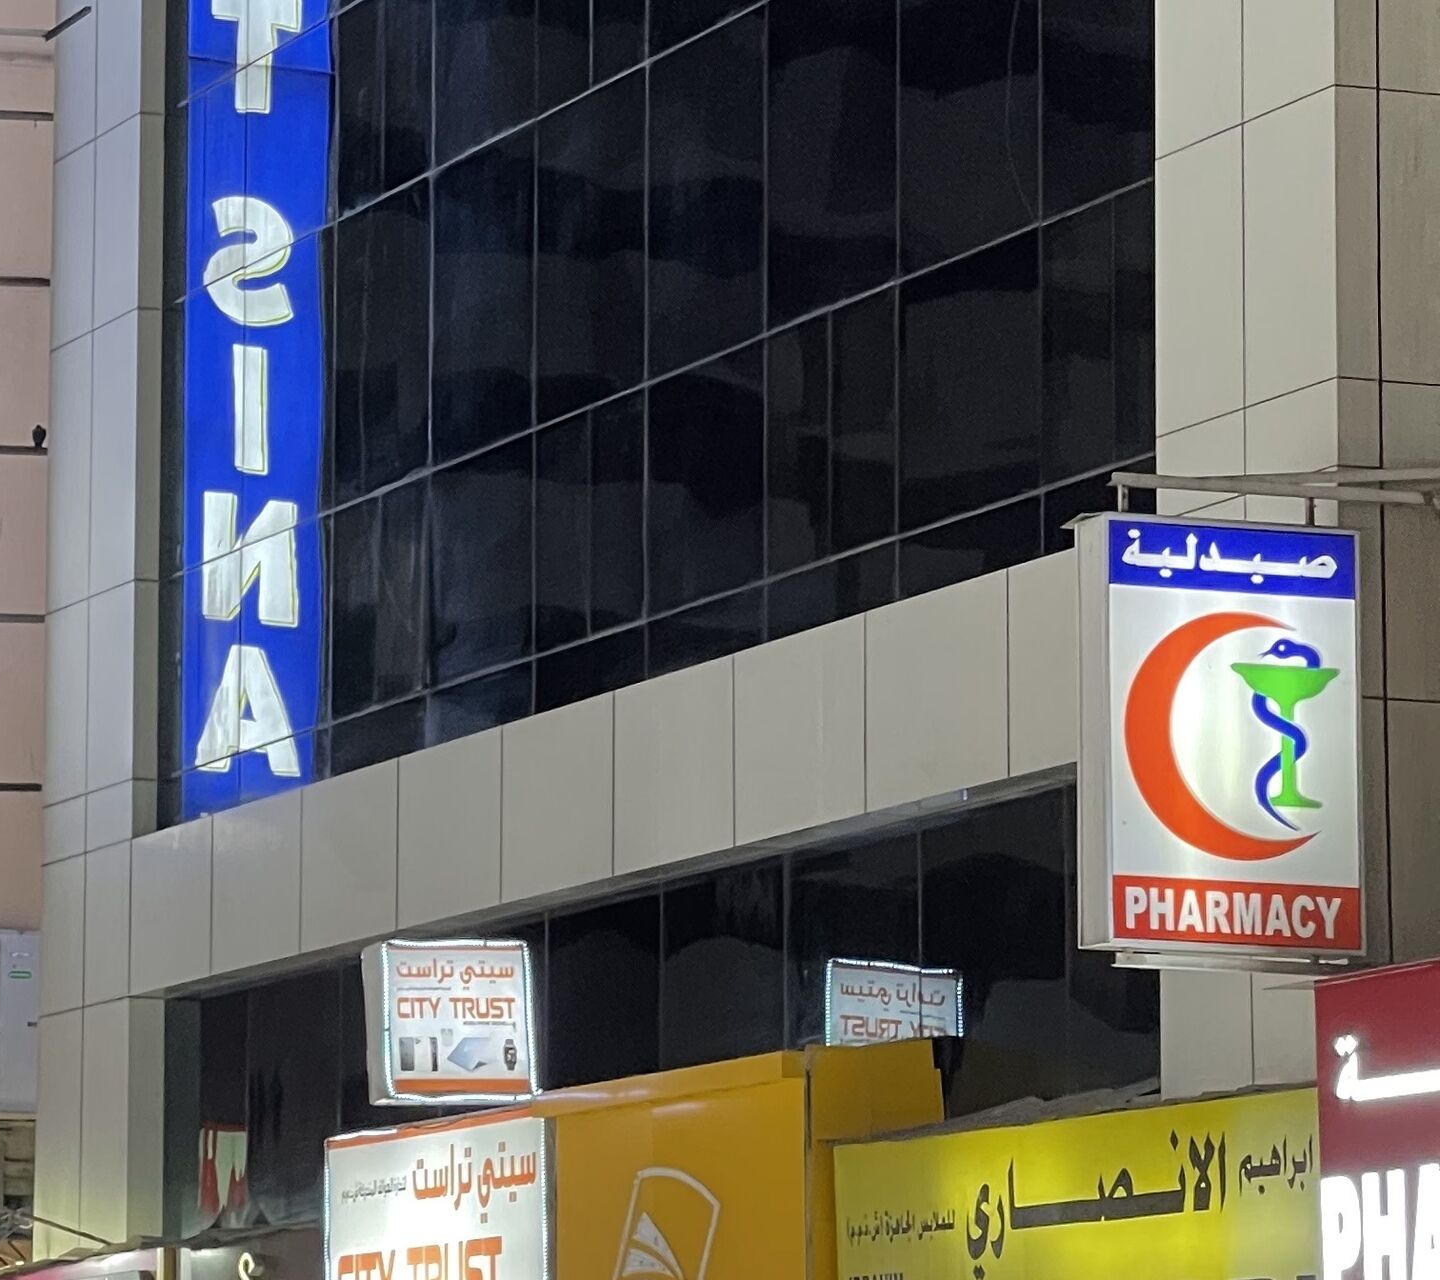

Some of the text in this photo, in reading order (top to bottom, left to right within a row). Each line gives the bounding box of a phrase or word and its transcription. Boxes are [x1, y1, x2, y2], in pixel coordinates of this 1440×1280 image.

[1121, 528, 1339, 584] صيدلية
[1124, 885, 1342, 939] PHARMACY
[396, 958, 514, 990] سيتي تراست
[397, 997, 515, 1019] CITY TRUST
[412, 1144, 472, 1210] تراست
[477, 1141, 536, 1224] سيتي
[1239, 1134, 1313, 1194] ابراهيم
